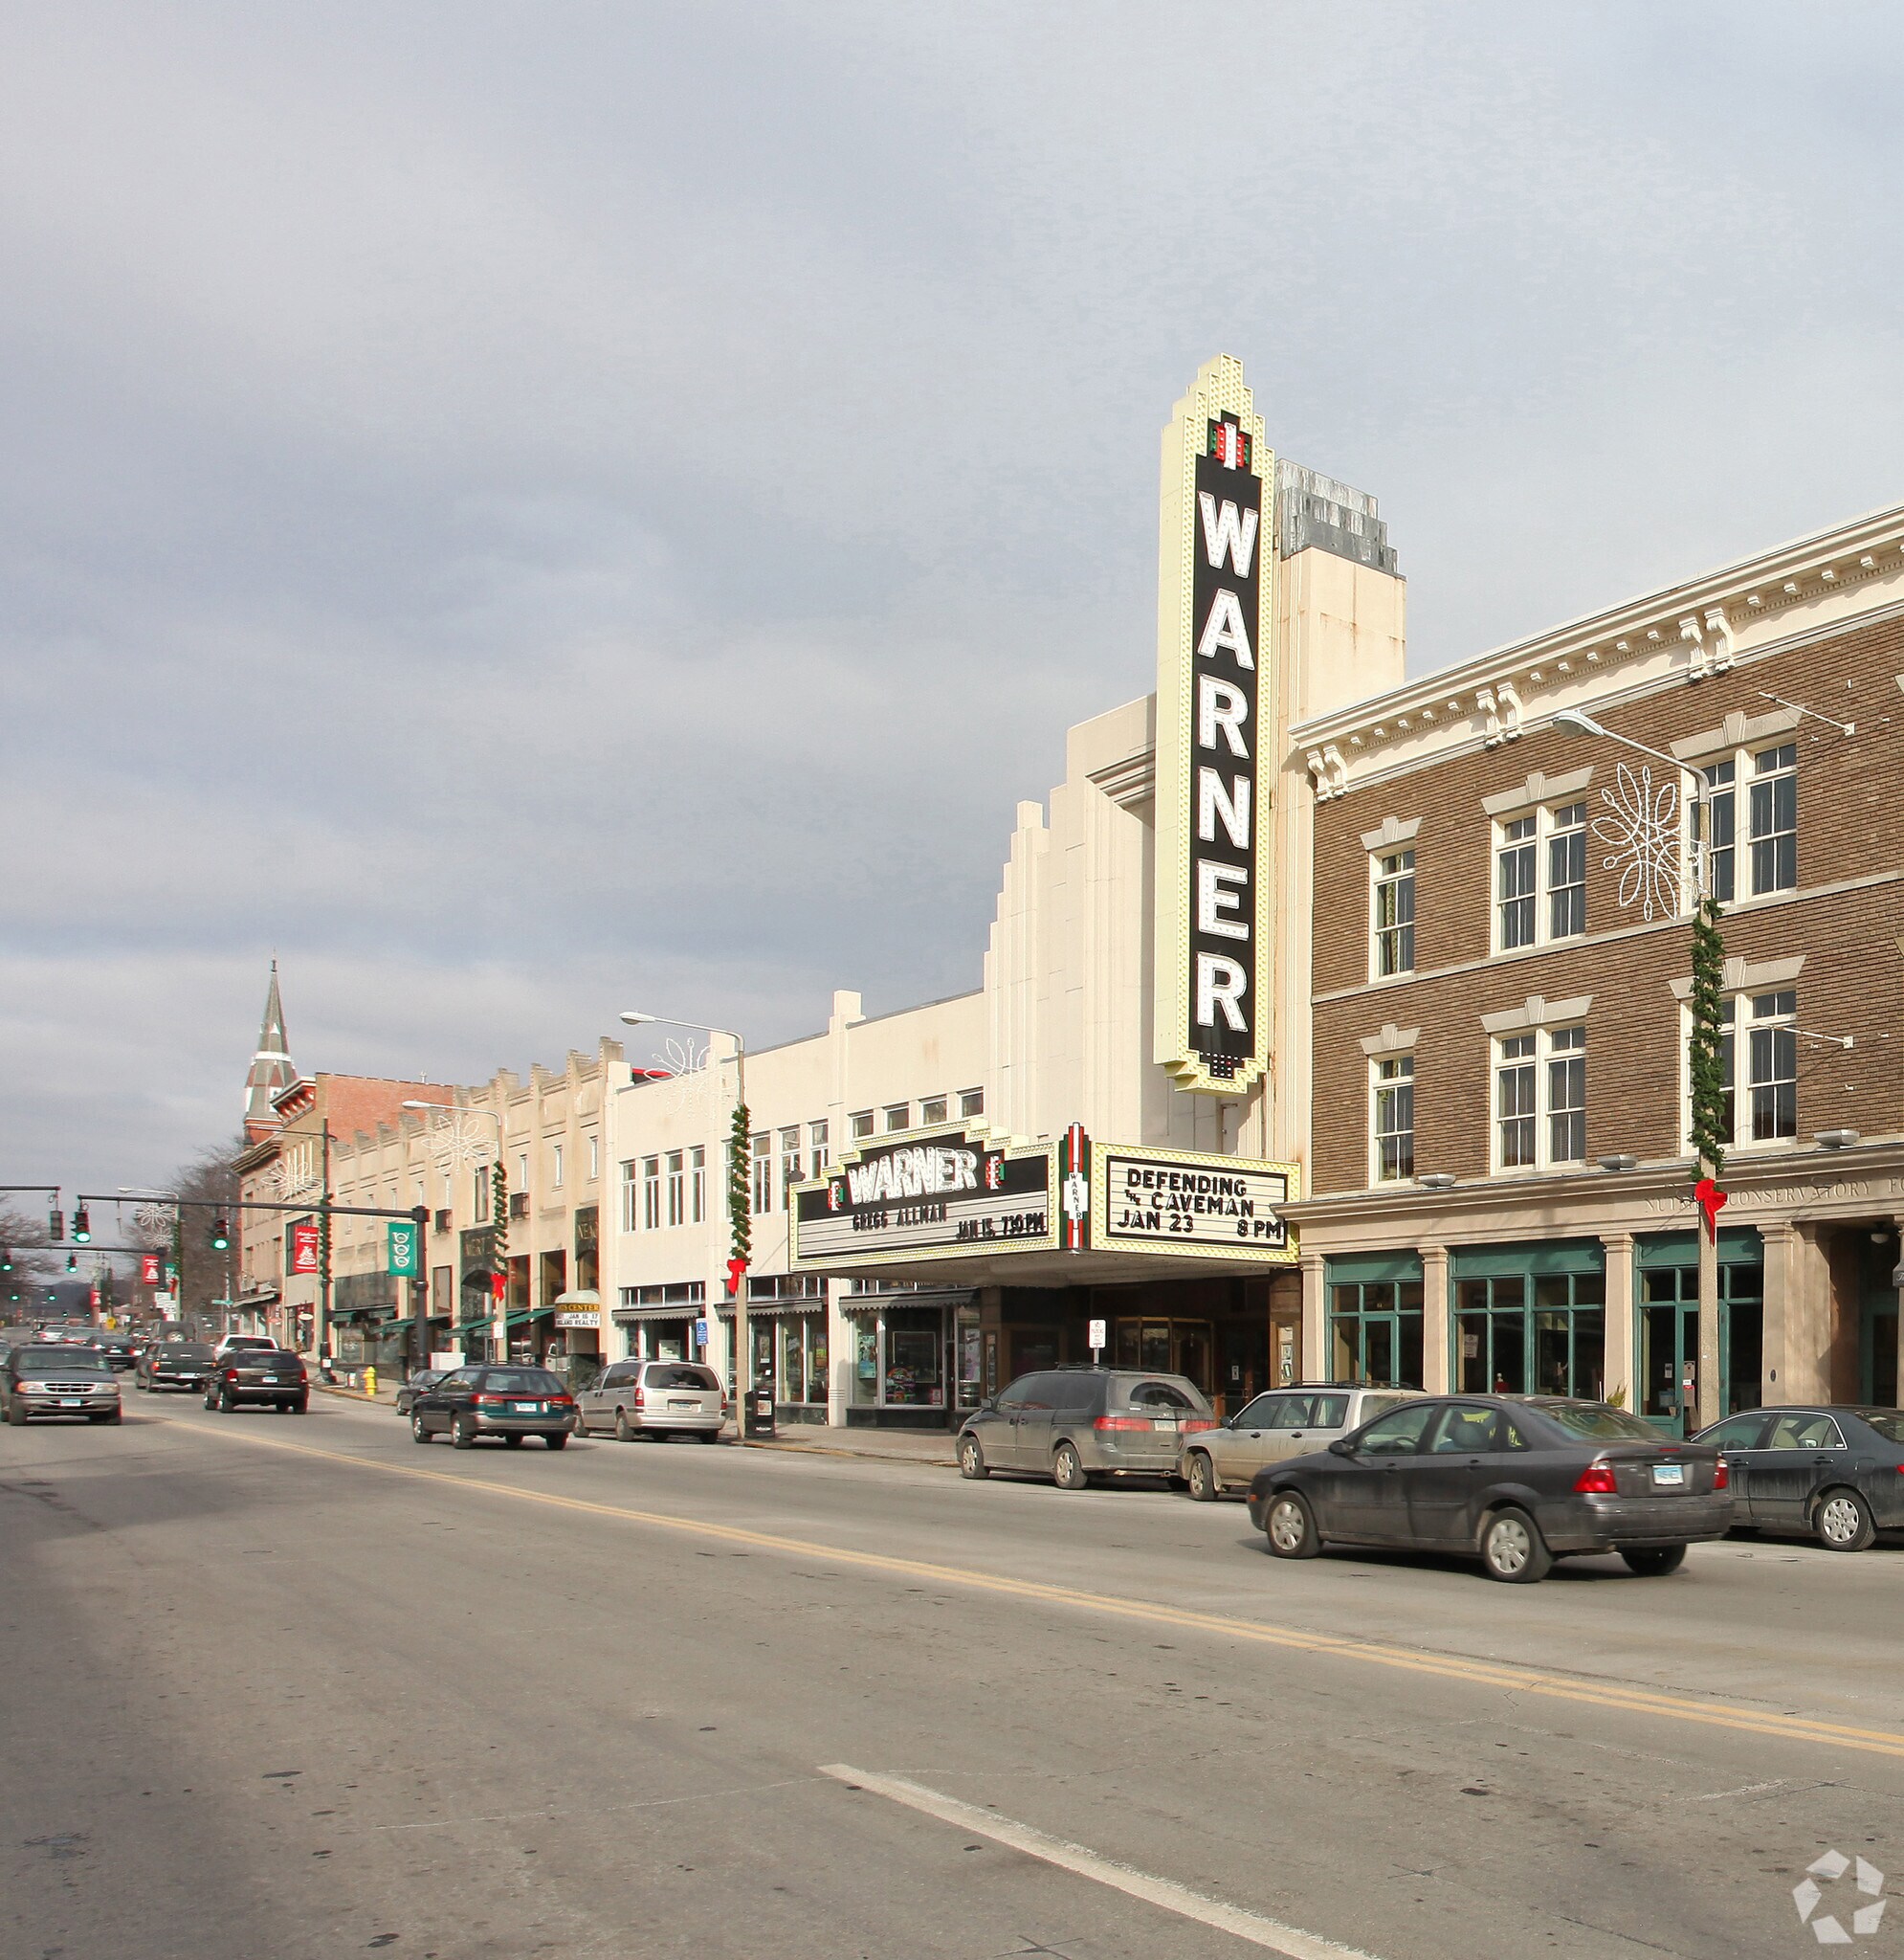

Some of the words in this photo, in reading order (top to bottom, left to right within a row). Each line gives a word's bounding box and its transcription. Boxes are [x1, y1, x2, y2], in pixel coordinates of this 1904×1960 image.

[1197, 490, 1259, 1033] WARNER
[848, 1147, 978, 1206] WARNER
[1127, 1168, 1247, 1197] DEFENDING
[1070, 1173, 1082, 1219] WARNER
[1124, 1190, 1140, 1206] THE
[1151, 1192, 1253, 1217] CAVEMAN
[852, 1211, 888, 1232] GREGG
[897, 1203, 946, 1227] ALLMAN
[1026, 1212, 1044, 1233] PM
[1118, 1210, 1161, 1231] JAN
[1169, 1213, 1194, 1234] 23
[1237, 1218, 1249, 1236] 8
[1253, 1220, 1282, 1239] PM
